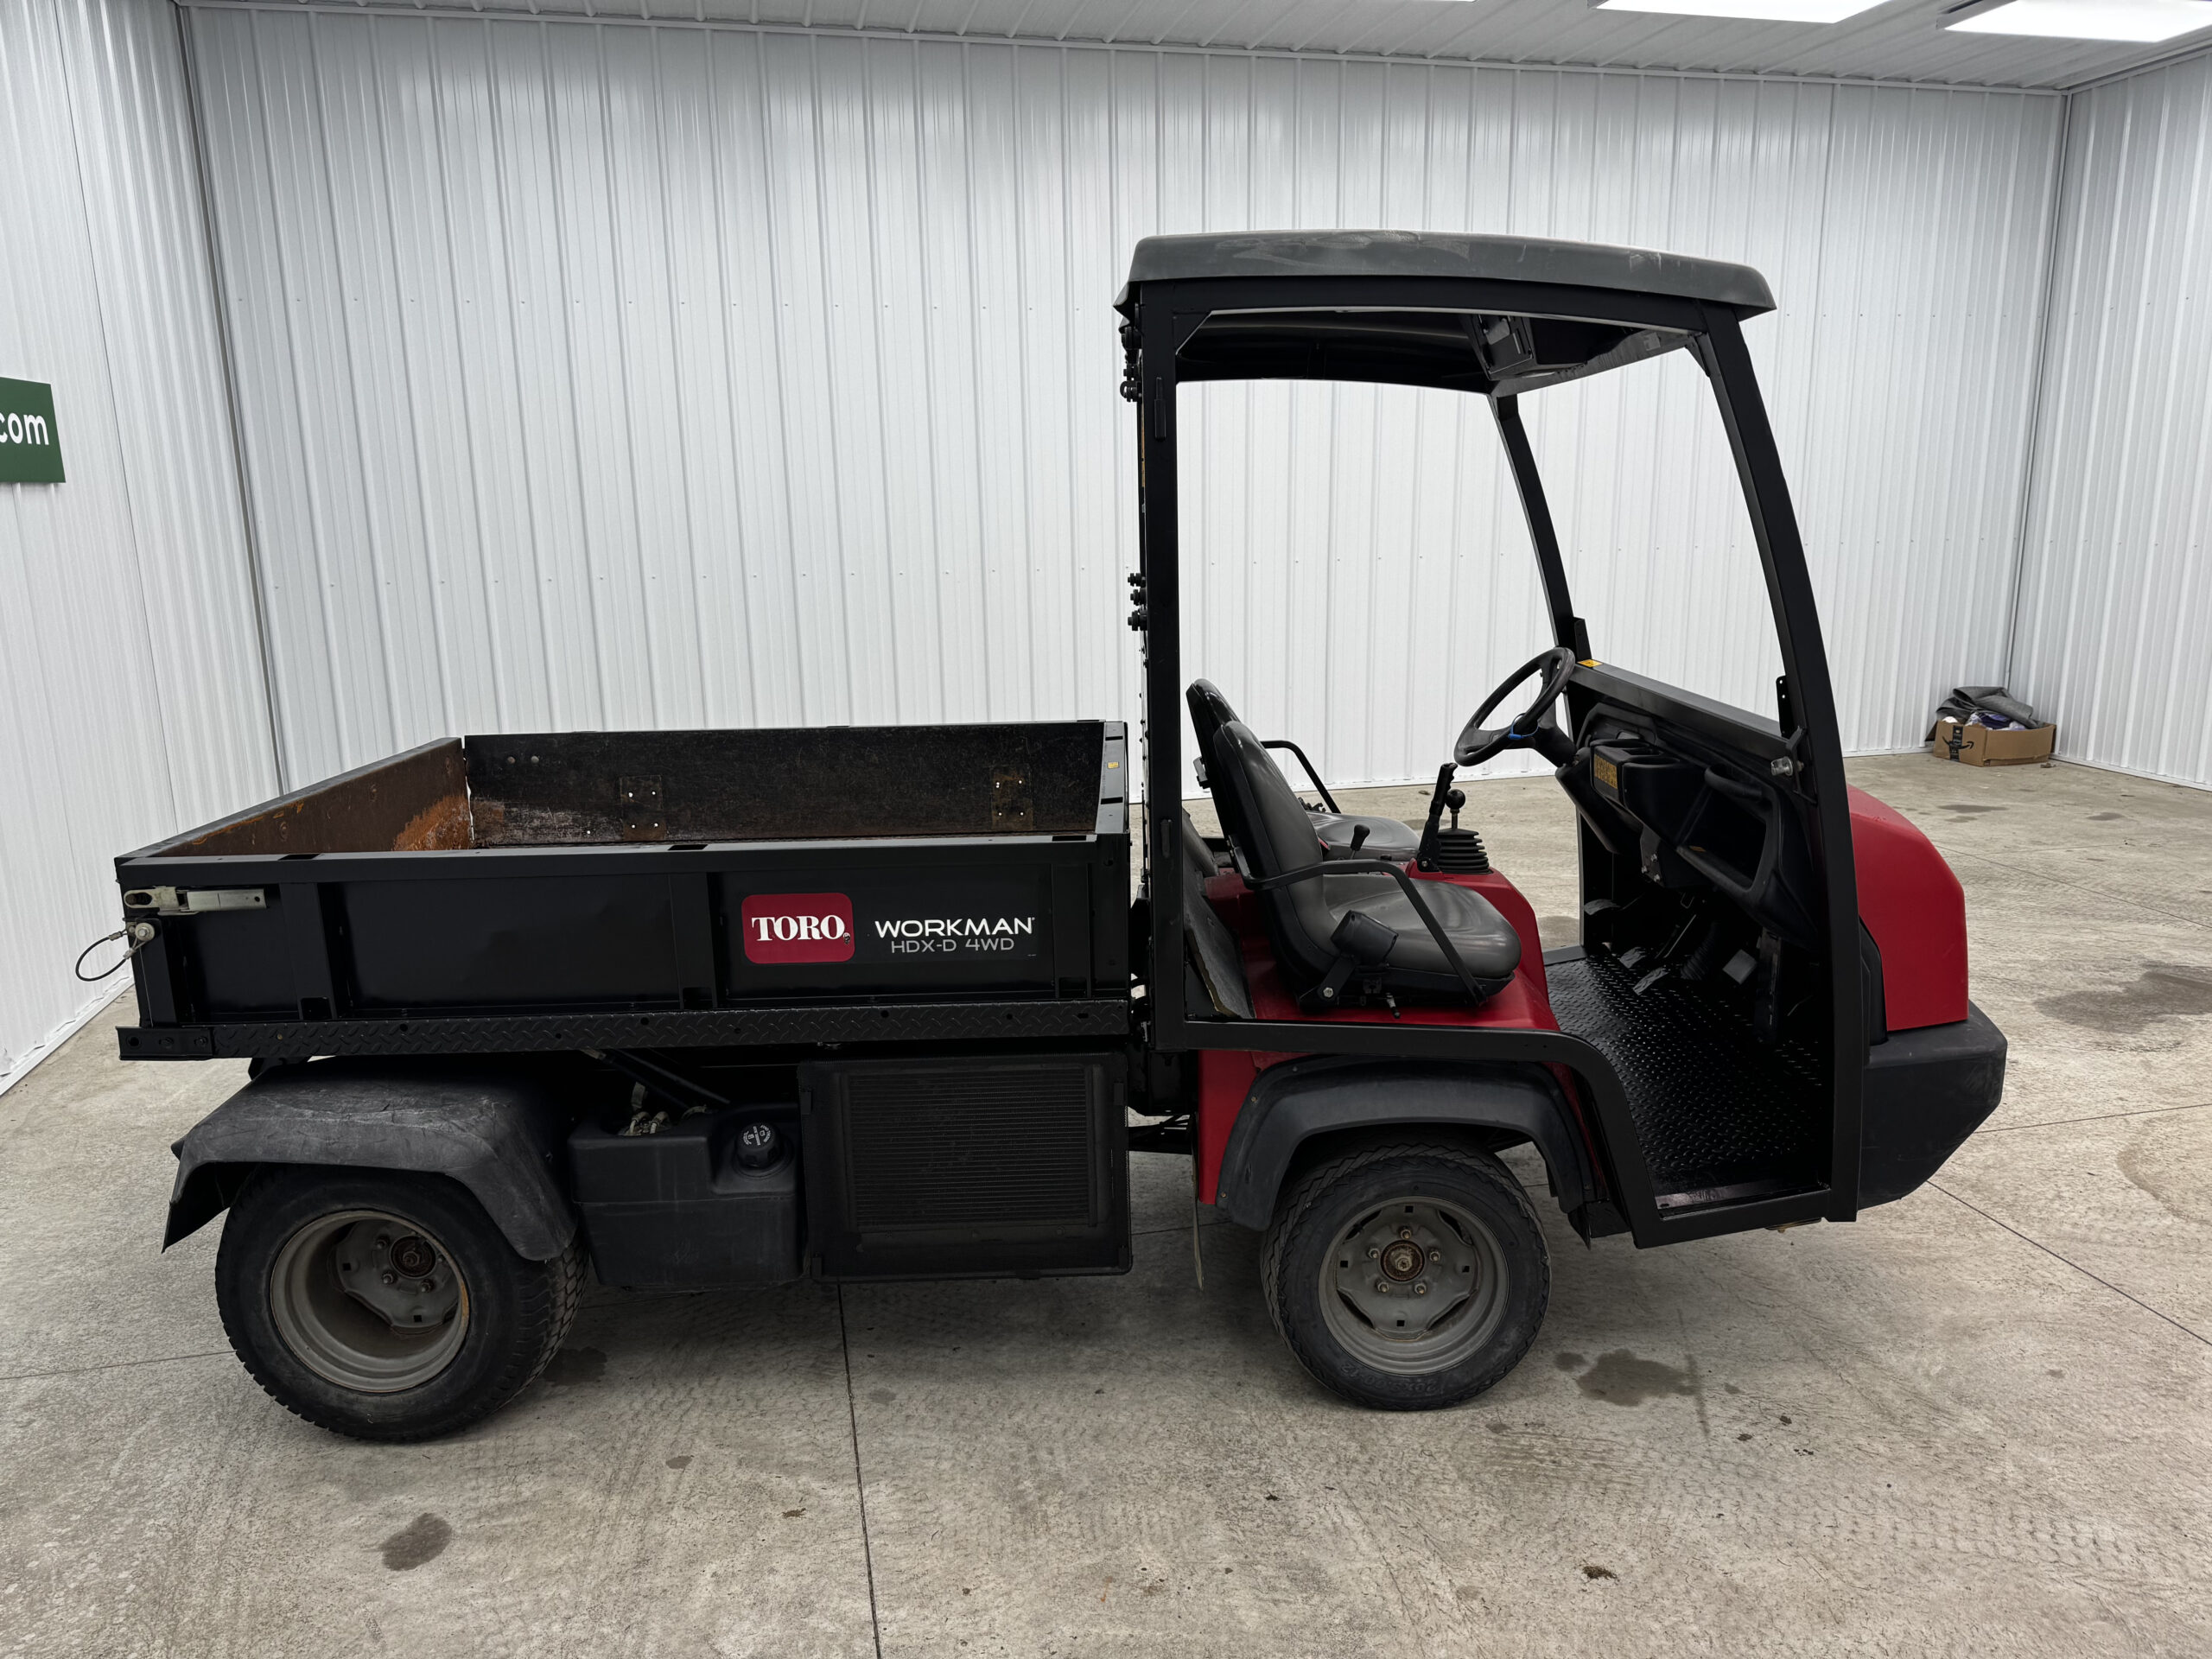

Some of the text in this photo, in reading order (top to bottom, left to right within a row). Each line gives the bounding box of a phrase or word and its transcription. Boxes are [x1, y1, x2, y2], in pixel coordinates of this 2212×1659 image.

[751, 914, 845, 941] TORO
[874, 917, 1033, 938] WORKMAN
[891, 938, 1014, 954] HDX-D 4WD
